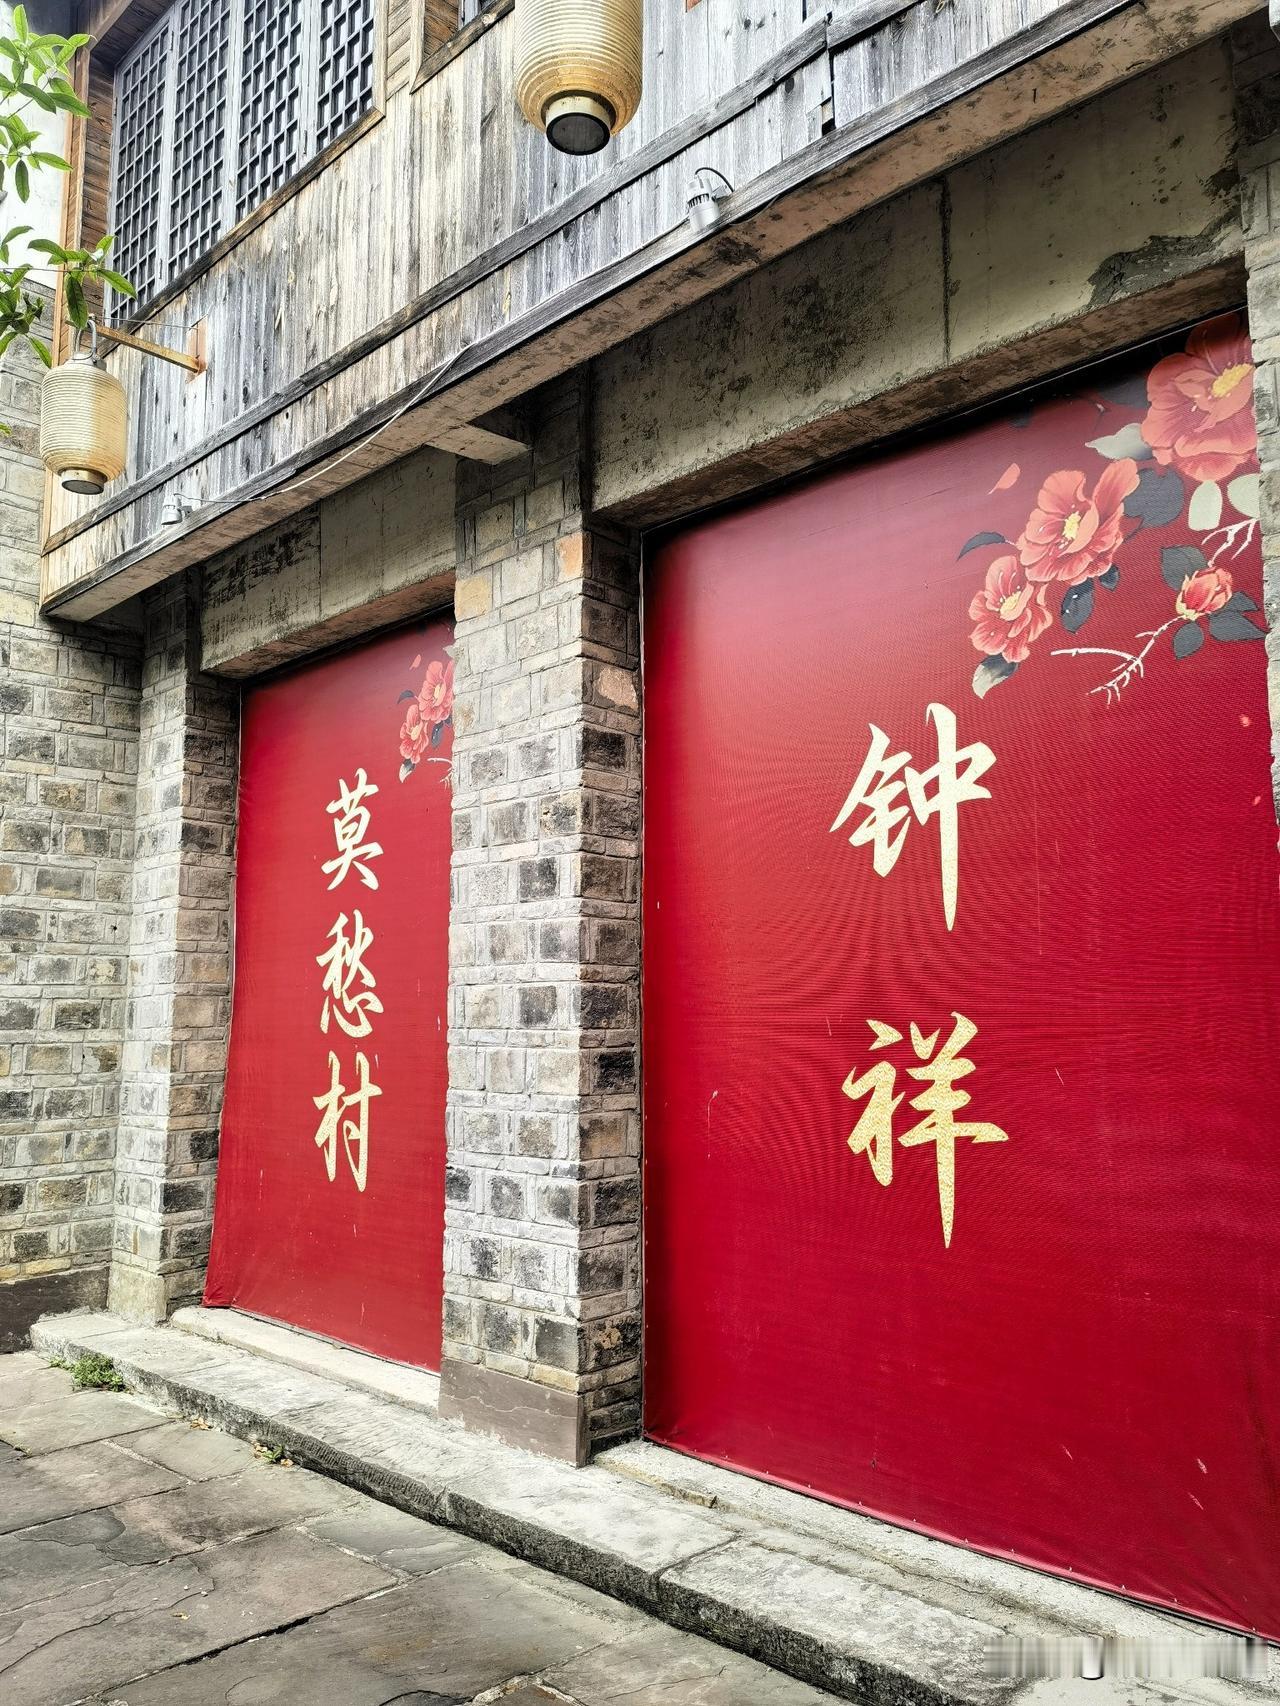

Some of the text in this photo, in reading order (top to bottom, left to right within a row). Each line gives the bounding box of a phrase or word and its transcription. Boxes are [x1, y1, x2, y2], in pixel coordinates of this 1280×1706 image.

[312, 768, 384, 1193] 莫愁村
[829, 702, 1009, 1249] 钟祥
